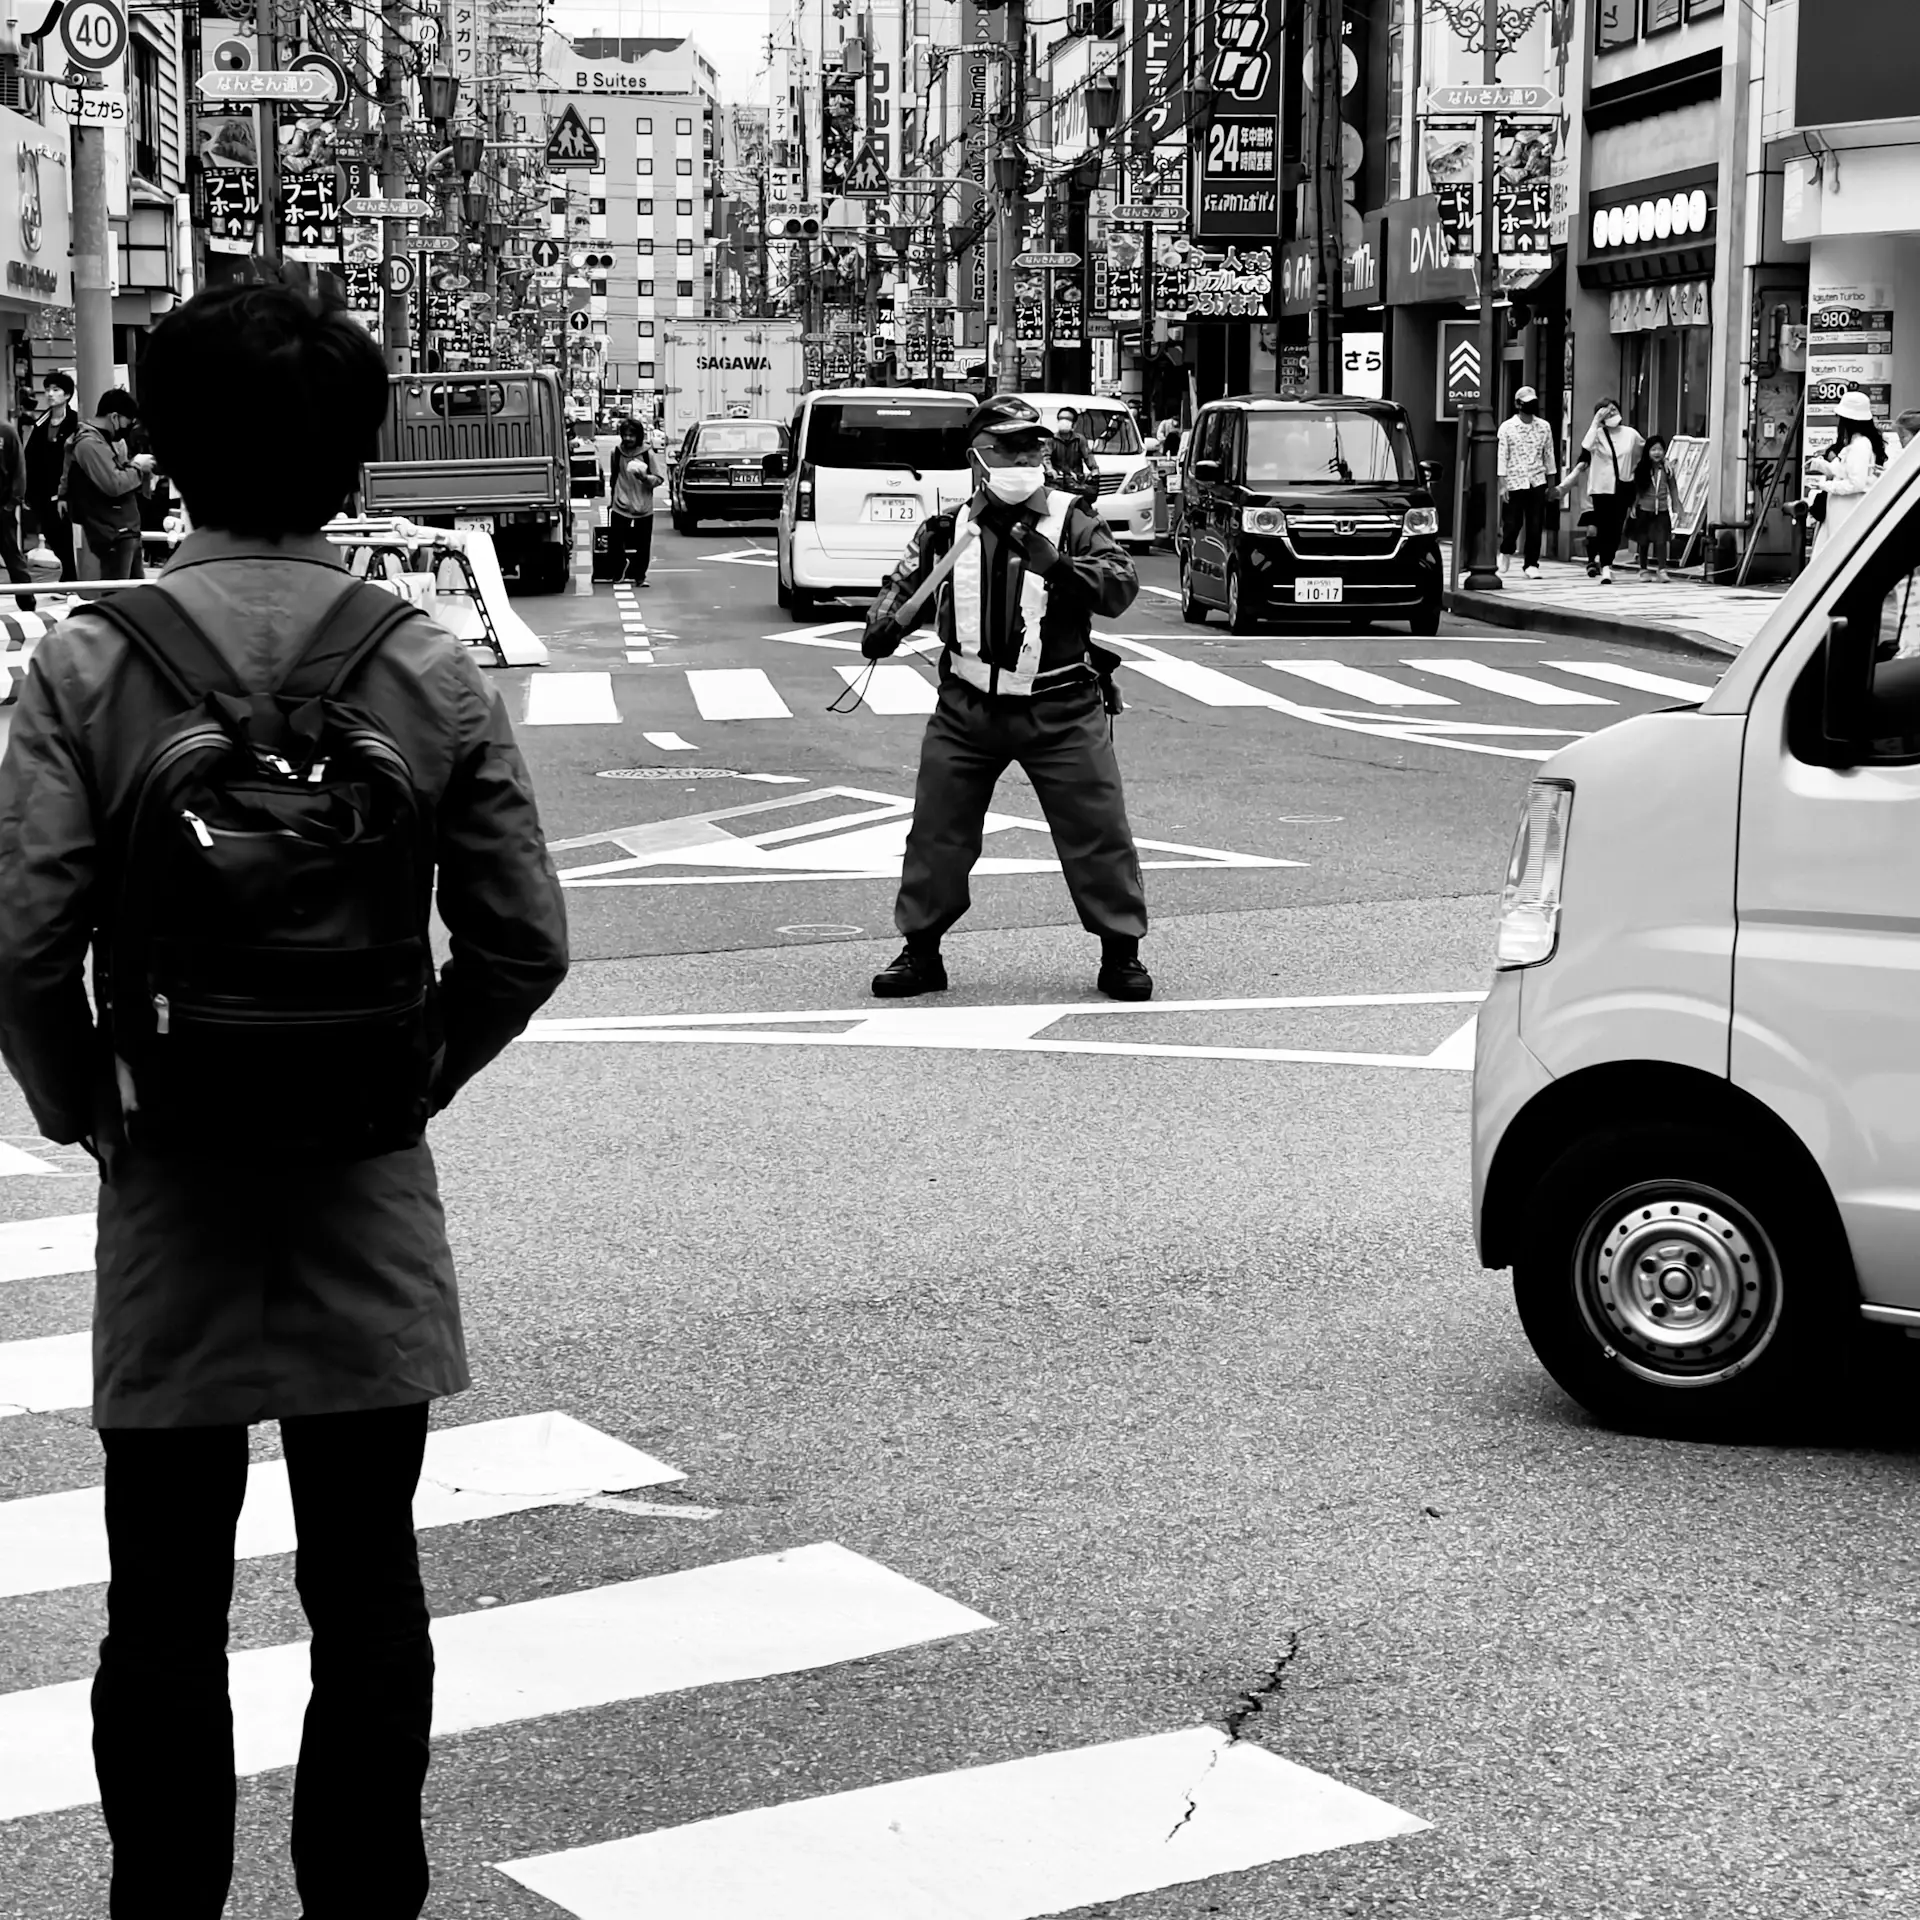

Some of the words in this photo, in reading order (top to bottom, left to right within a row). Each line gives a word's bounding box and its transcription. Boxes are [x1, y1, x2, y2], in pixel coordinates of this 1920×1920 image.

[76, 15, 111, 48] 40
[217, 76, 313, 93] なんさん通り
[576, 72, 588, 87] B
[593, 72, 647, 88] Suites
[1448, 90, 1538, 105] なんさん通り
[71, 100, 124, 119] ここから
[1241, 127, 1273, 147] 年中無休
[1207, 123, 1239, 171] 24
[1240, 151, 1272, 171] 時間営業
[206, 175, 255, 196] フード
[283, 182, 333, 203] フード
[210, 196, 260, 216] ホール
[356, 201, 419, 214] なんさん通り
[1500, 190, 1547, 213] フード
[285, 203, 341, 224] ホール
[1121, 207, 1179, 218] なんさん通り
[1501, 211, 1550, 234] ホール
[406, 238, 450, 249] んさん通り
[345, 268, 378, 283] フード
[1109, 270, 1139, 284] フード
[1156, 270, 1186, 284] フード
[346, 282, 380, 297] ホール
[1109, 282, 1142, 297] ホール
[1156, 282, 1187, 297] ホール
[429, 295, 456, 307] フード
[429, 306, 457, 317] ホール
[1016, 307, 1041, 318] フード
[1054, 307, 1080, 318] フード
[1016, 317, 1043, 328] ホール
[1055, 317, 1081, 328] ホール
[1821, 311, 1850, 328] 980
[696, 356, 772, 371] SAGAWA
[1344, 351, 1382, 371] さら
[1448, 390, 1480, 399] DAISO
[1819, 383, 1848, 400] 980
